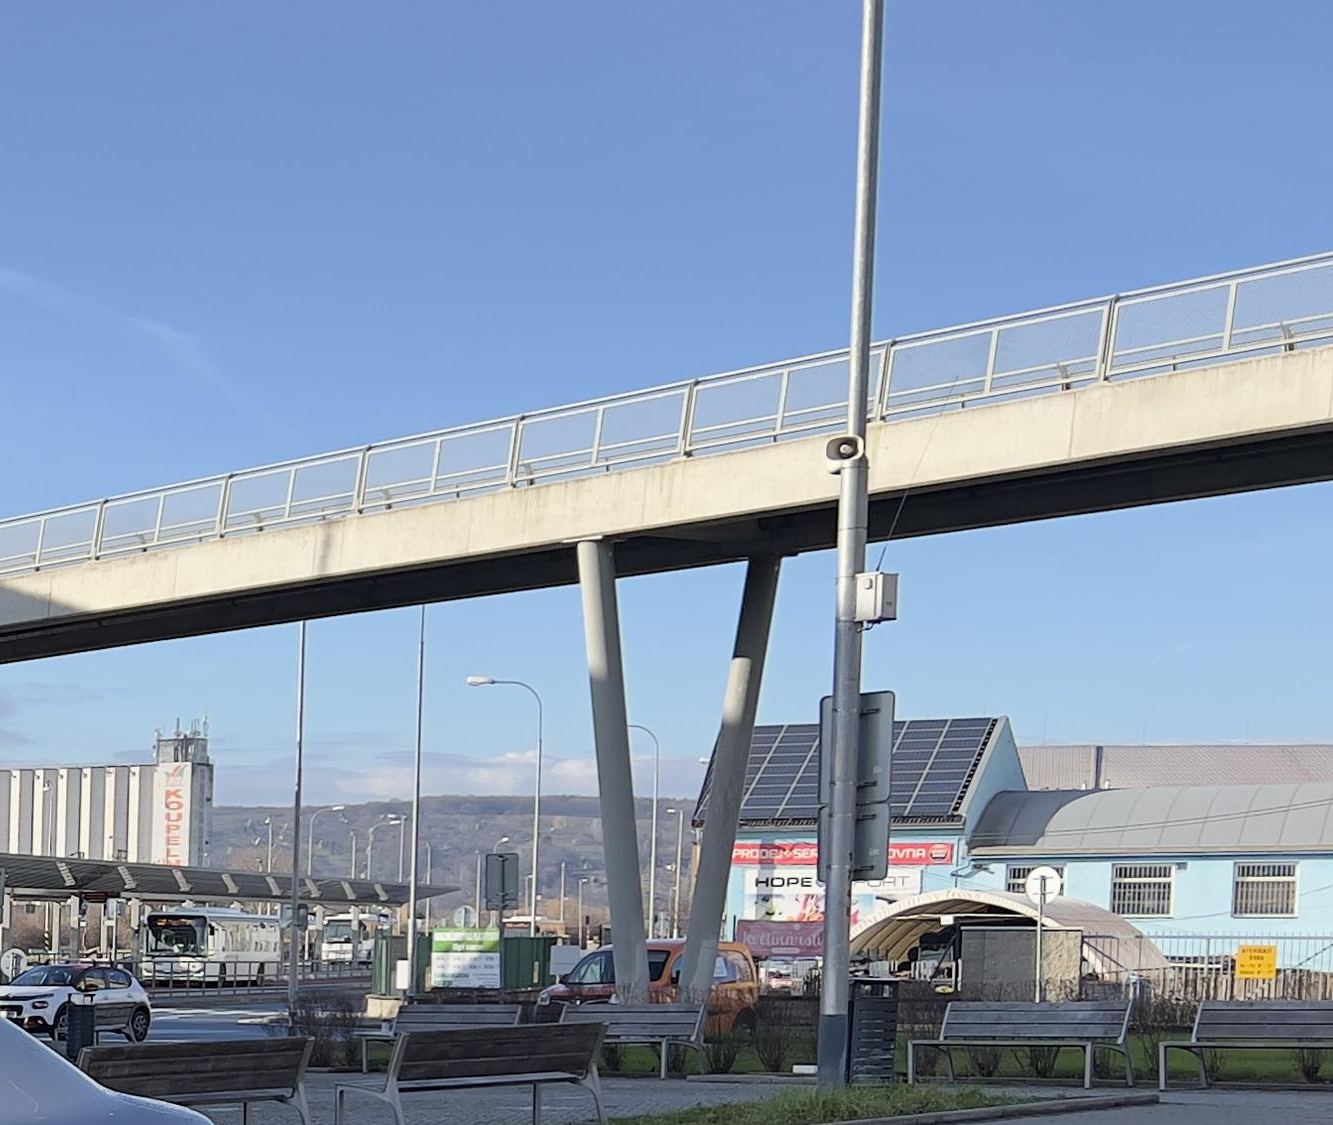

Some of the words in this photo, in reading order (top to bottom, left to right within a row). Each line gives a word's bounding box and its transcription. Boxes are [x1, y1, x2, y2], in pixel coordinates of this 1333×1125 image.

[793, 848, 818, 858] SER
[755, 877, 812, 888] HOPE
[853, 876, 911, 888] PORT
